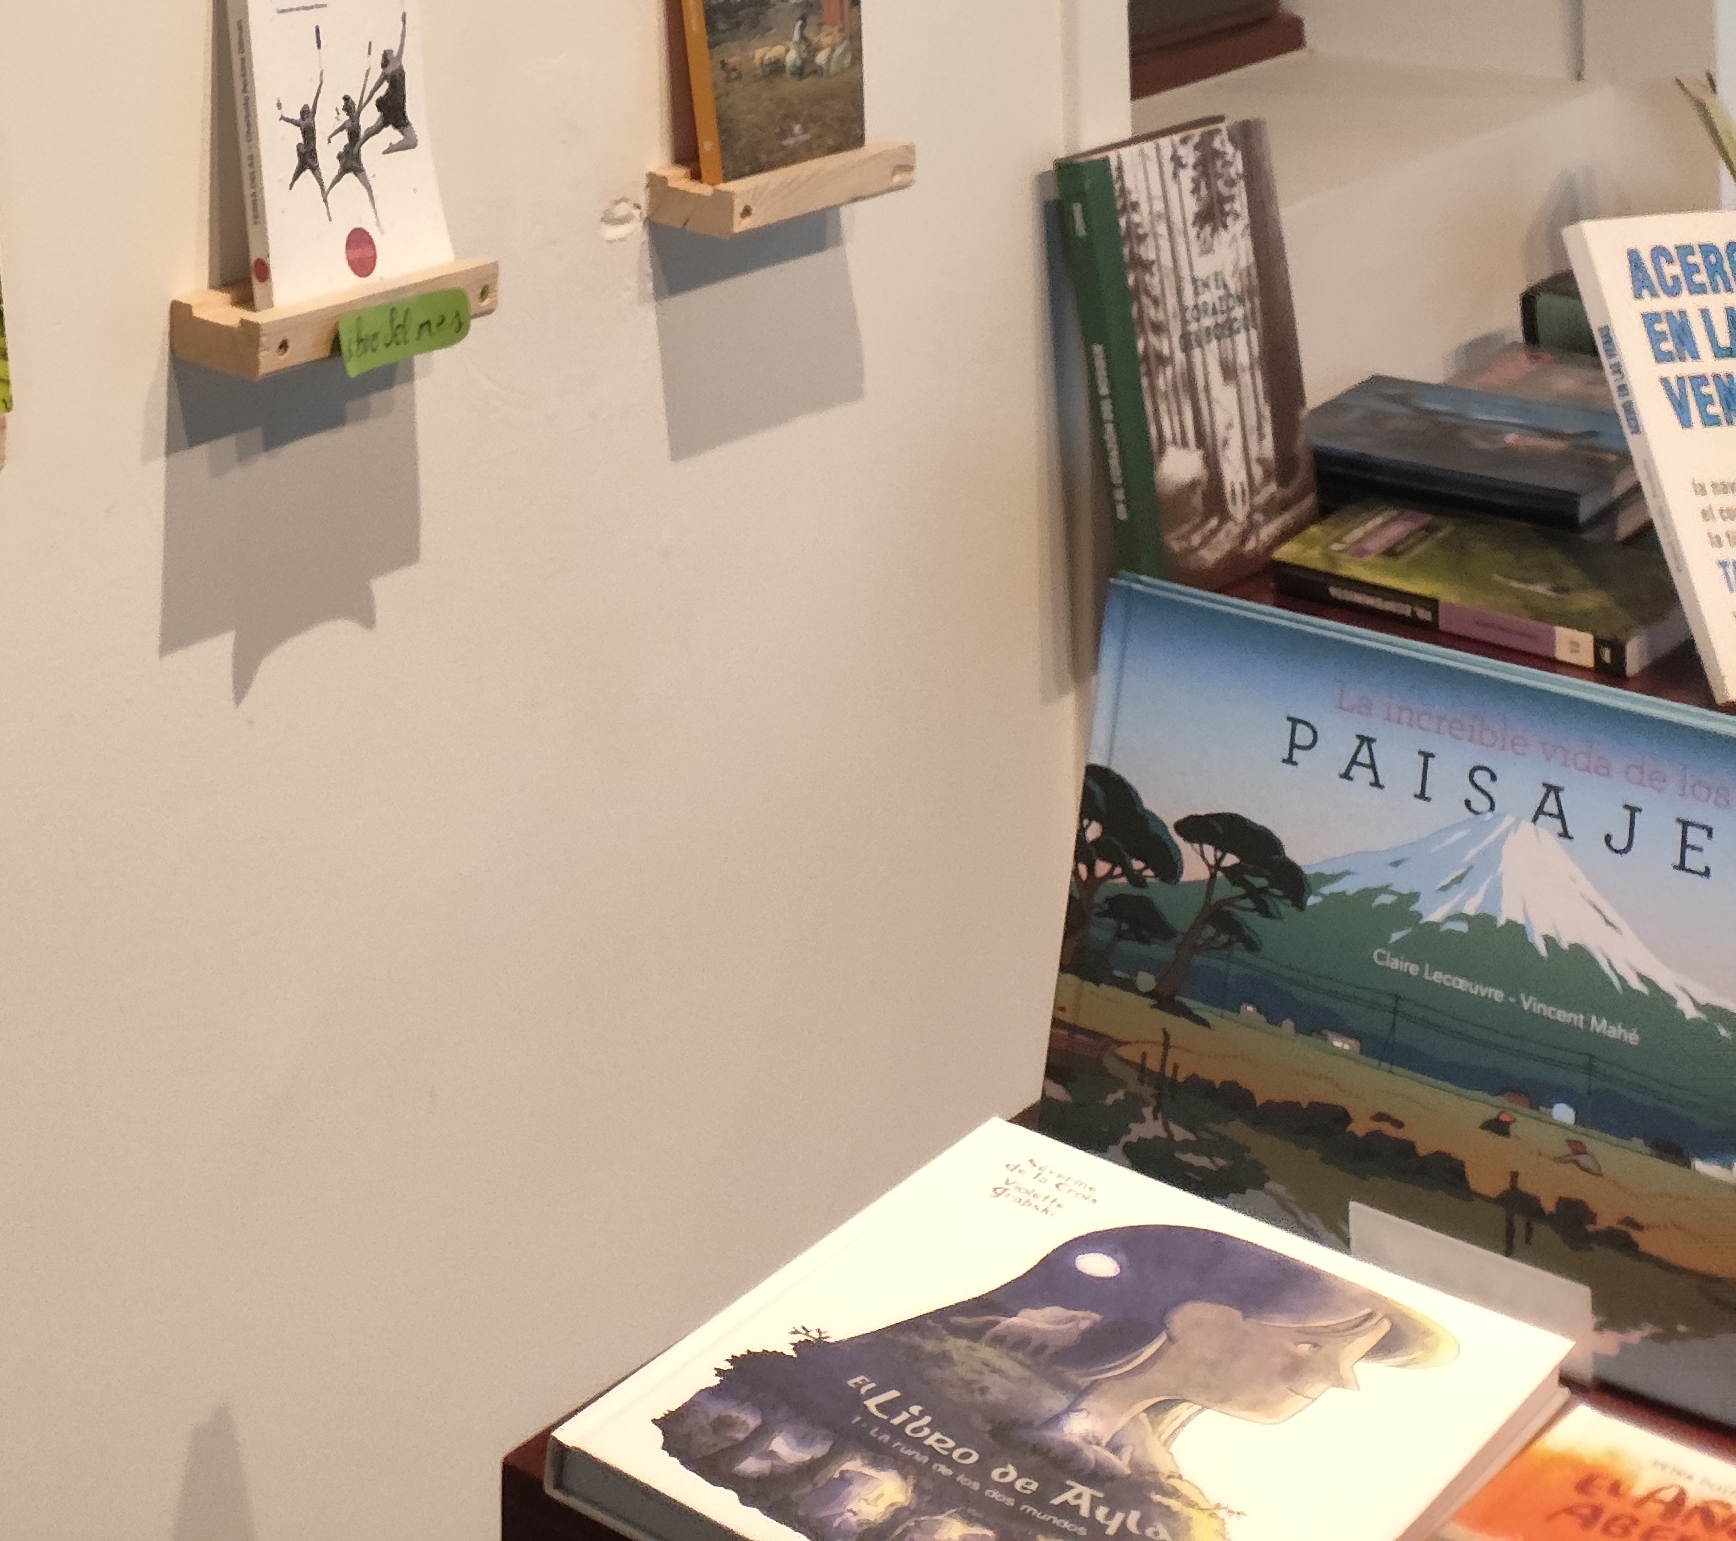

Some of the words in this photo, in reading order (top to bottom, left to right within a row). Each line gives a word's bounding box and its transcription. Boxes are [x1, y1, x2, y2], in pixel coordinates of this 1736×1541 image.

[1641, 310, 1701, 363] EN
[1338, 686, 1373, 716] La
[1540, 734, 1611, 780] vida
[1622, 758, 1669, 793] de
[1678, 760, 1733, 811] los
[1281, 714, 1714, 879] PAISAJE
[1372, 947, 1420, 976] Claire
[1520, 992, 1584, 1030] Vincent
[1589, 1014, 1640, 1046] Mahé
[932, 1461, 954, 1477] de
[956, 1473, 981, 1491] los
[984, 1488, 1015, 1507] dos
[1019, 1503, 1088, 1537] mundos
[990, 1463, 1040, 1495] de
[1049, 1479, 1171, 1541] Ayla
